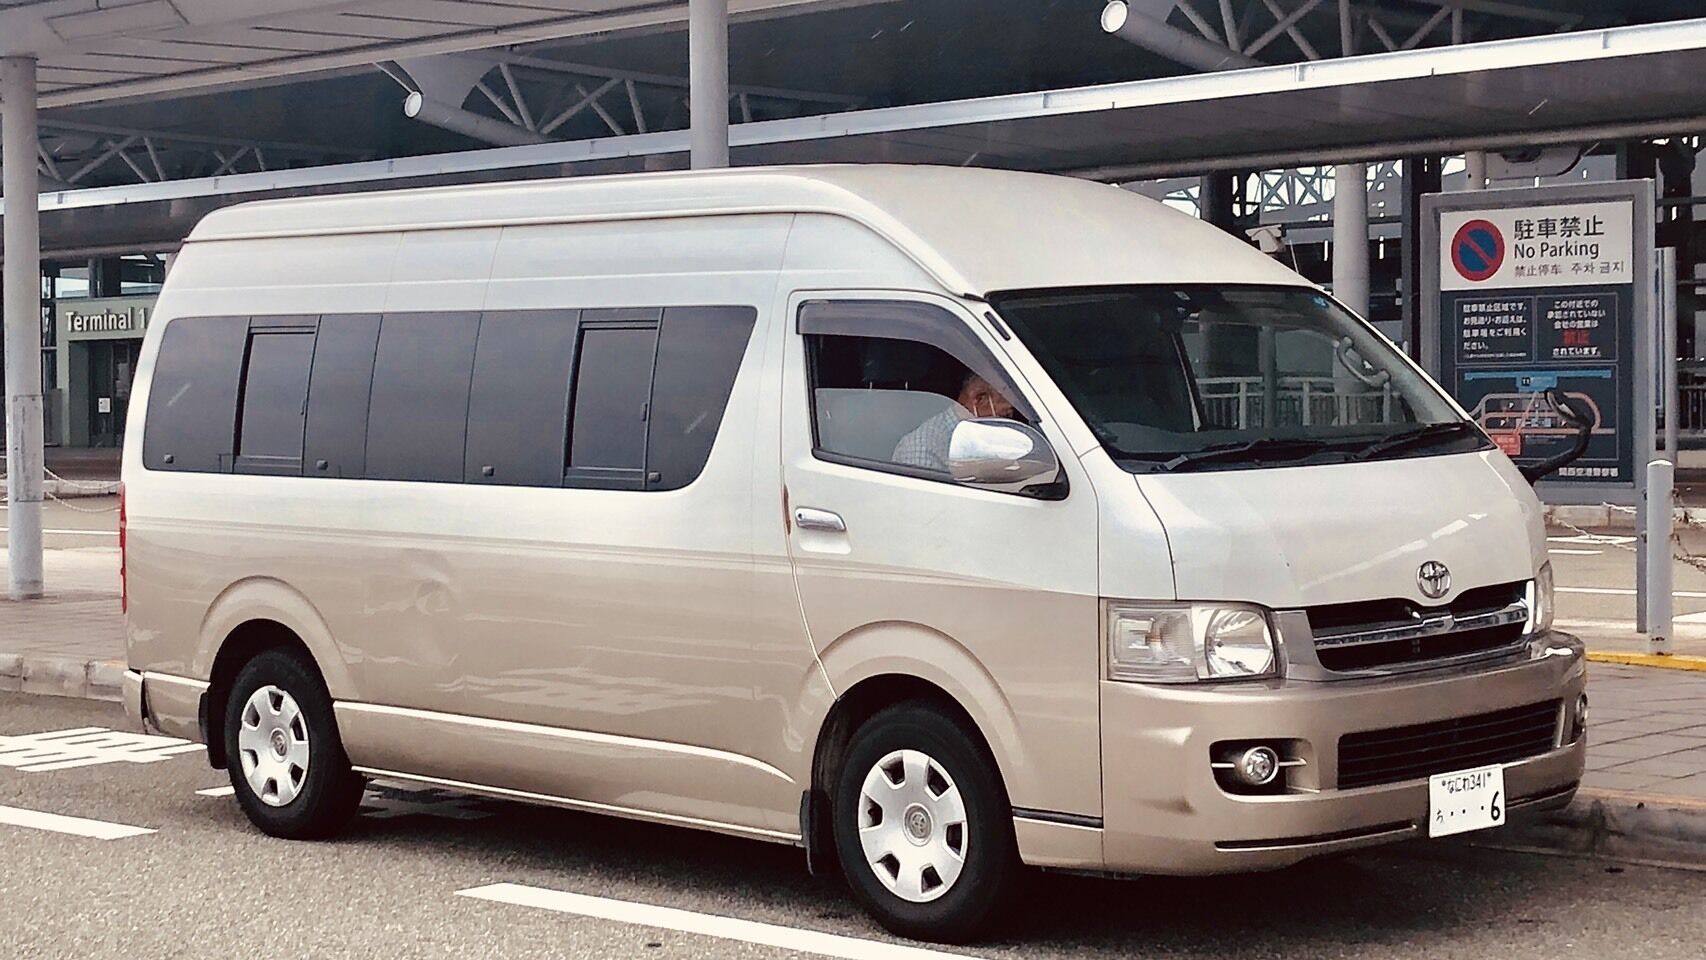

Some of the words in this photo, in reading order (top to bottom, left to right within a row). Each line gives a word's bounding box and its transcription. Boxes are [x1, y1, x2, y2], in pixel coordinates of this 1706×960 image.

[1514, 214, 1604, 240] 駐車禁止
[1514, 243, 1536, 259] No
[1540, 240, 1599, 259] Parking
[1514, 263, 1561, 278] 禁止停车
[1571, 262, 1595, 275] 주차
[1600, 261, 1624, 274] 금지
[65, 307, 132, 331] Terminal
[138, 307, 145, 329] 1
